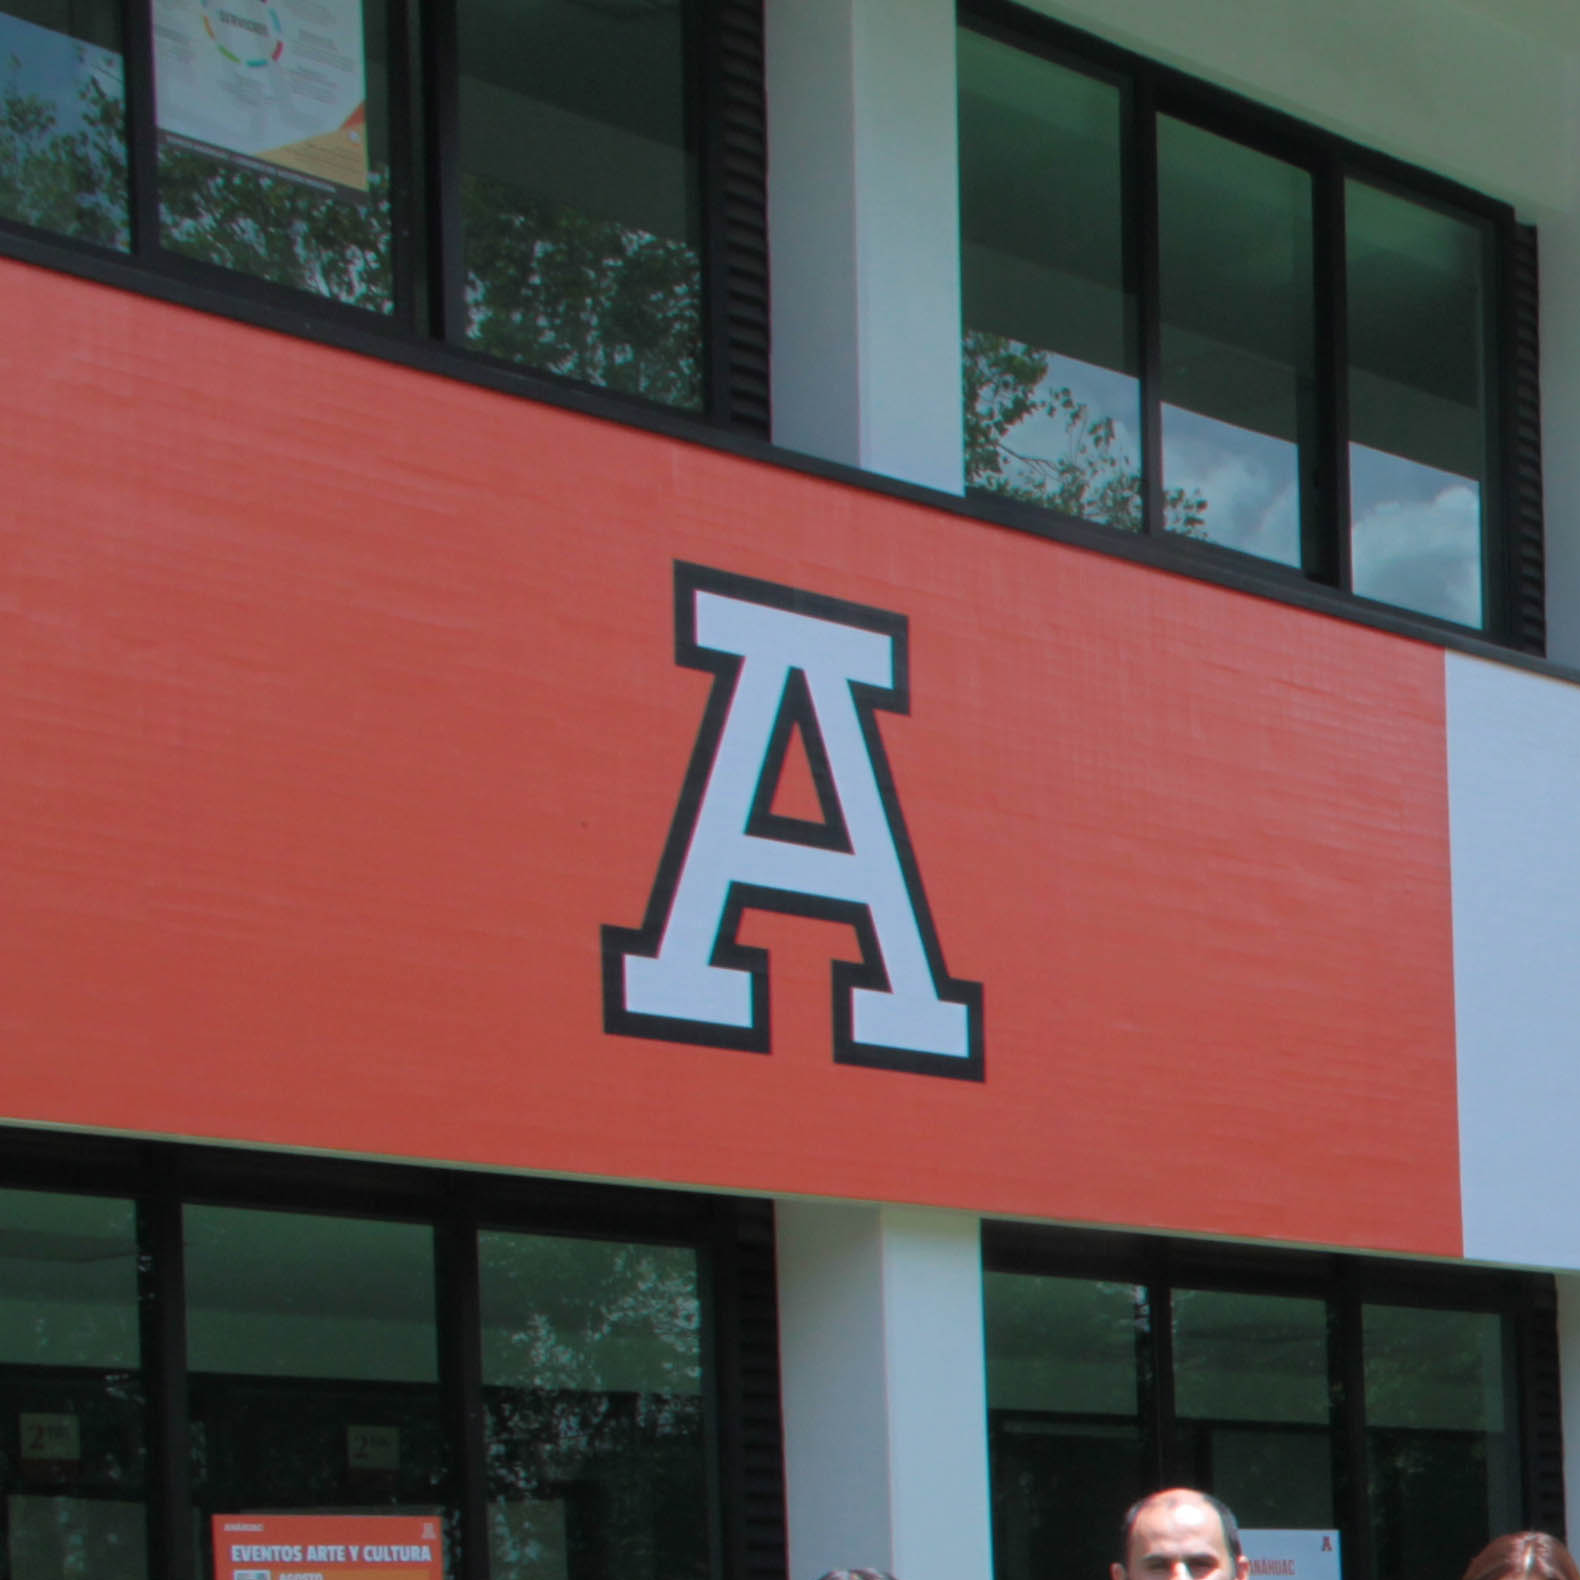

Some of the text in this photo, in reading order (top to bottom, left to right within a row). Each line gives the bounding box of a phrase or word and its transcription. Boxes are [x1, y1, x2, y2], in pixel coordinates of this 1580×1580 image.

[600, 558, 986, 1083] A
[1321, 1536, 1333, 1551] A
[231, 1545, 433, 1563] EVENTOS ARTE Y CULTURA
